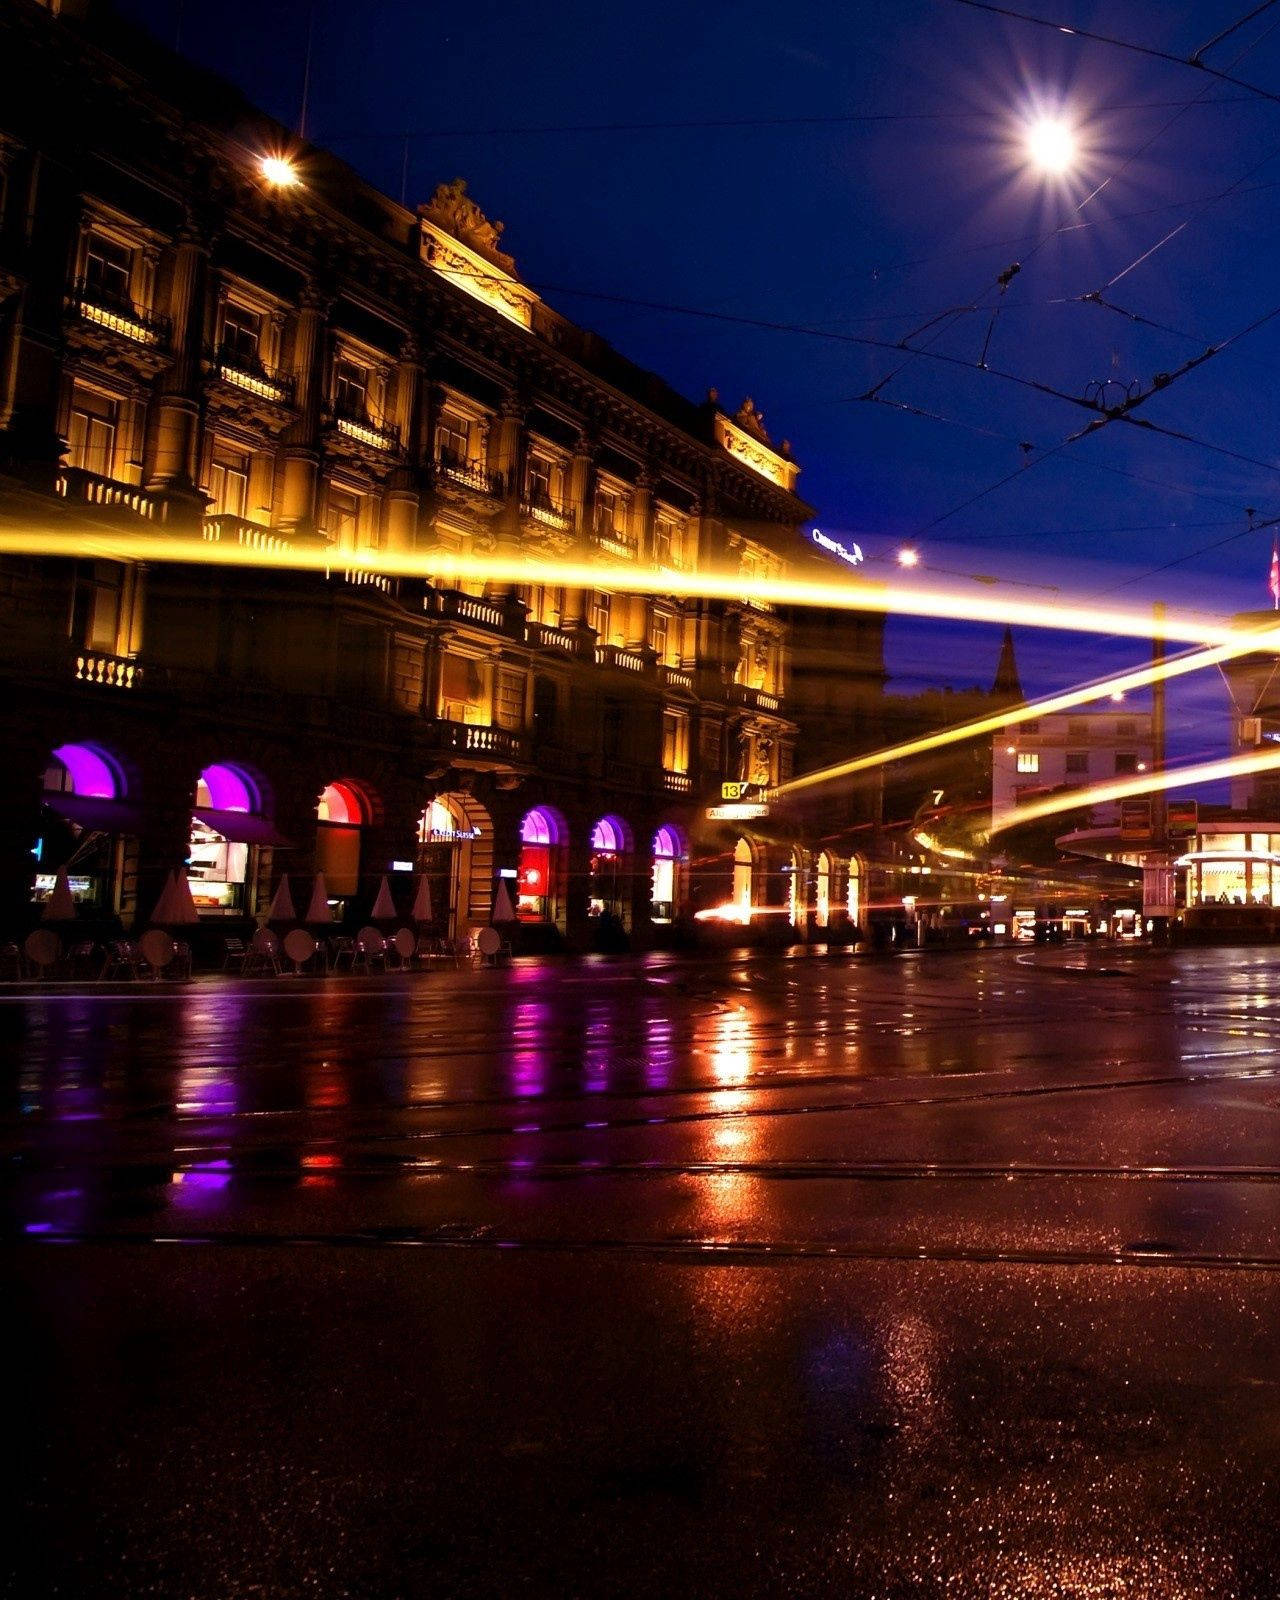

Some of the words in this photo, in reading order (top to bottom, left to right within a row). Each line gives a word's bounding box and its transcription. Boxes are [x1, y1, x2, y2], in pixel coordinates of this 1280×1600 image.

[723, 785, 739, 798] 13
[740, 782, 749, 794] 7
[932, 790, 944, 805] 7
